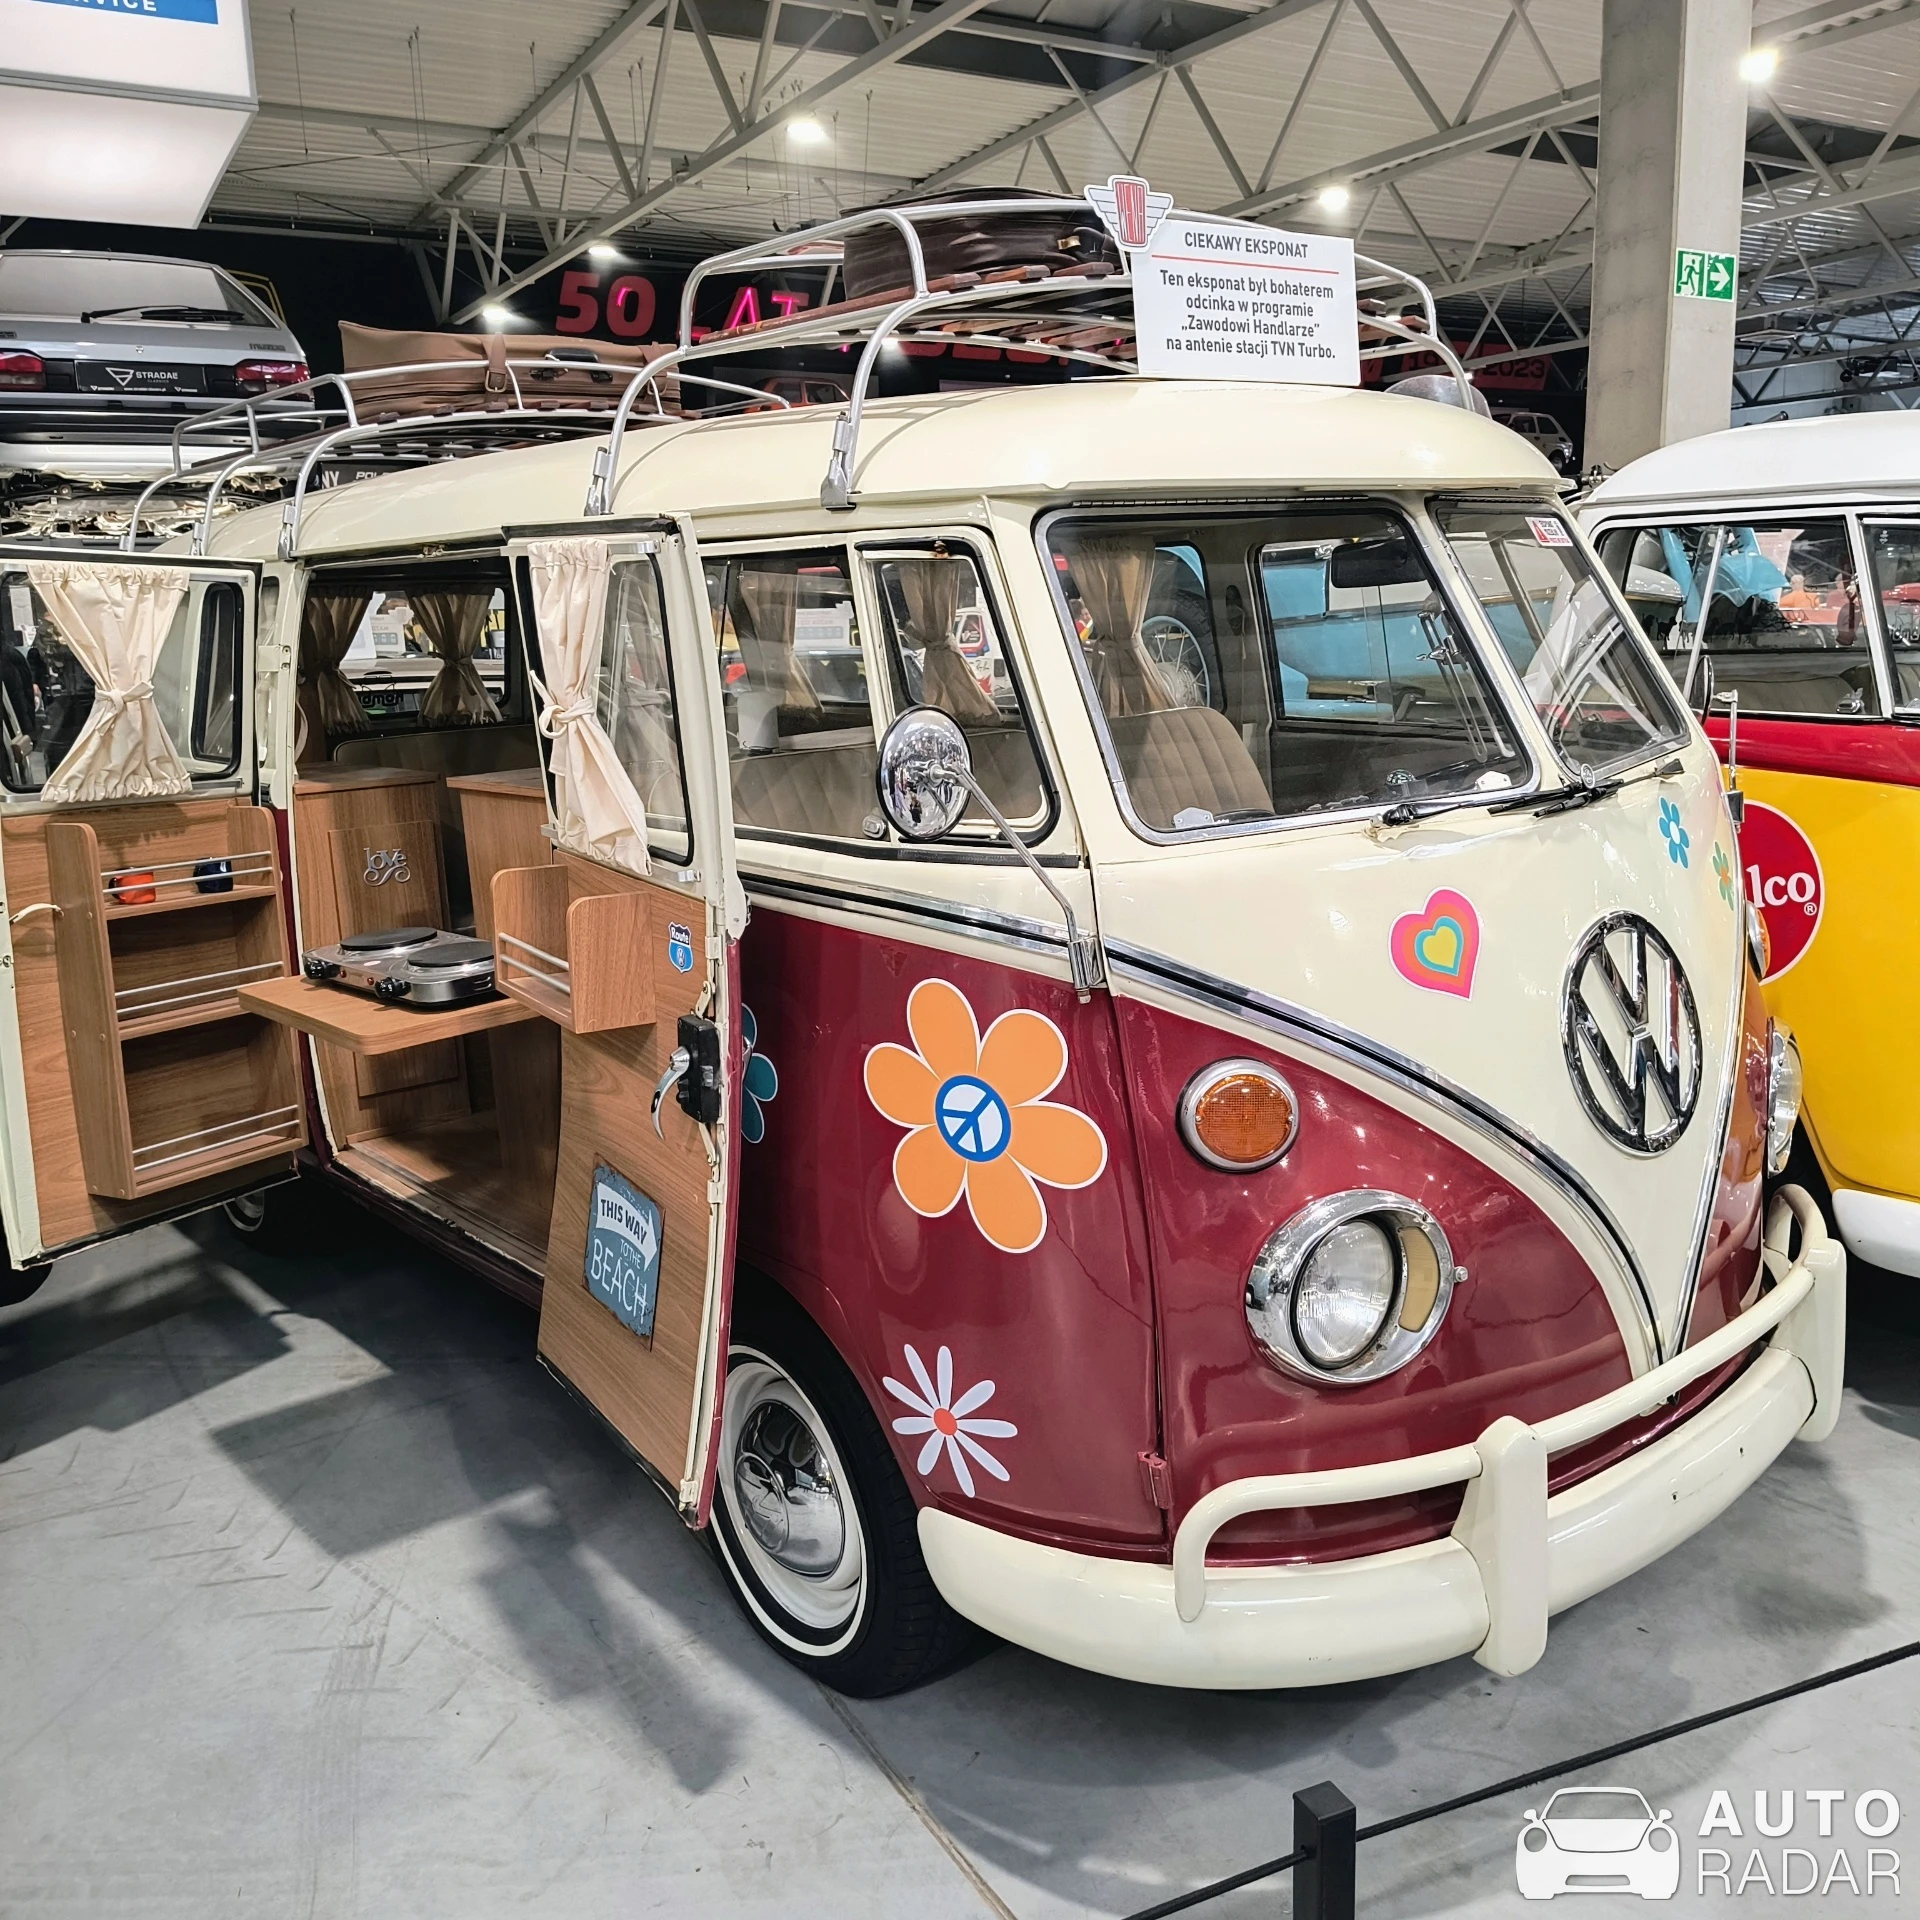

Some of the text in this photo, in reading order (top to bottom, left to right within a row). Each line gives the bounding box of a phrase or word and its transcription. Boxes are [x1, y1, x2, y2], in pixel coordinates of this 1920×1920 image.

[1184, 231, 1308, 259] CIEKAWY EKSPONAT
[1160, 269, 1334, 299] Ten eksponat był bohaterem
[555, 270, 656, 338] 50
[1186, 294, 1314, 318] odcinka w programie
[1181, 315, 1250, 334] „Zawodowi
[1166, 337, 1336, 359] na antenie stacji TVN Turbo.
[363, 847, 410, 887] love
[600, 1198, 648, 1246] THIS WAY
[620, 1238, 641, 1270] TO THE
[590, 1238, 648, 1325] BEACH
